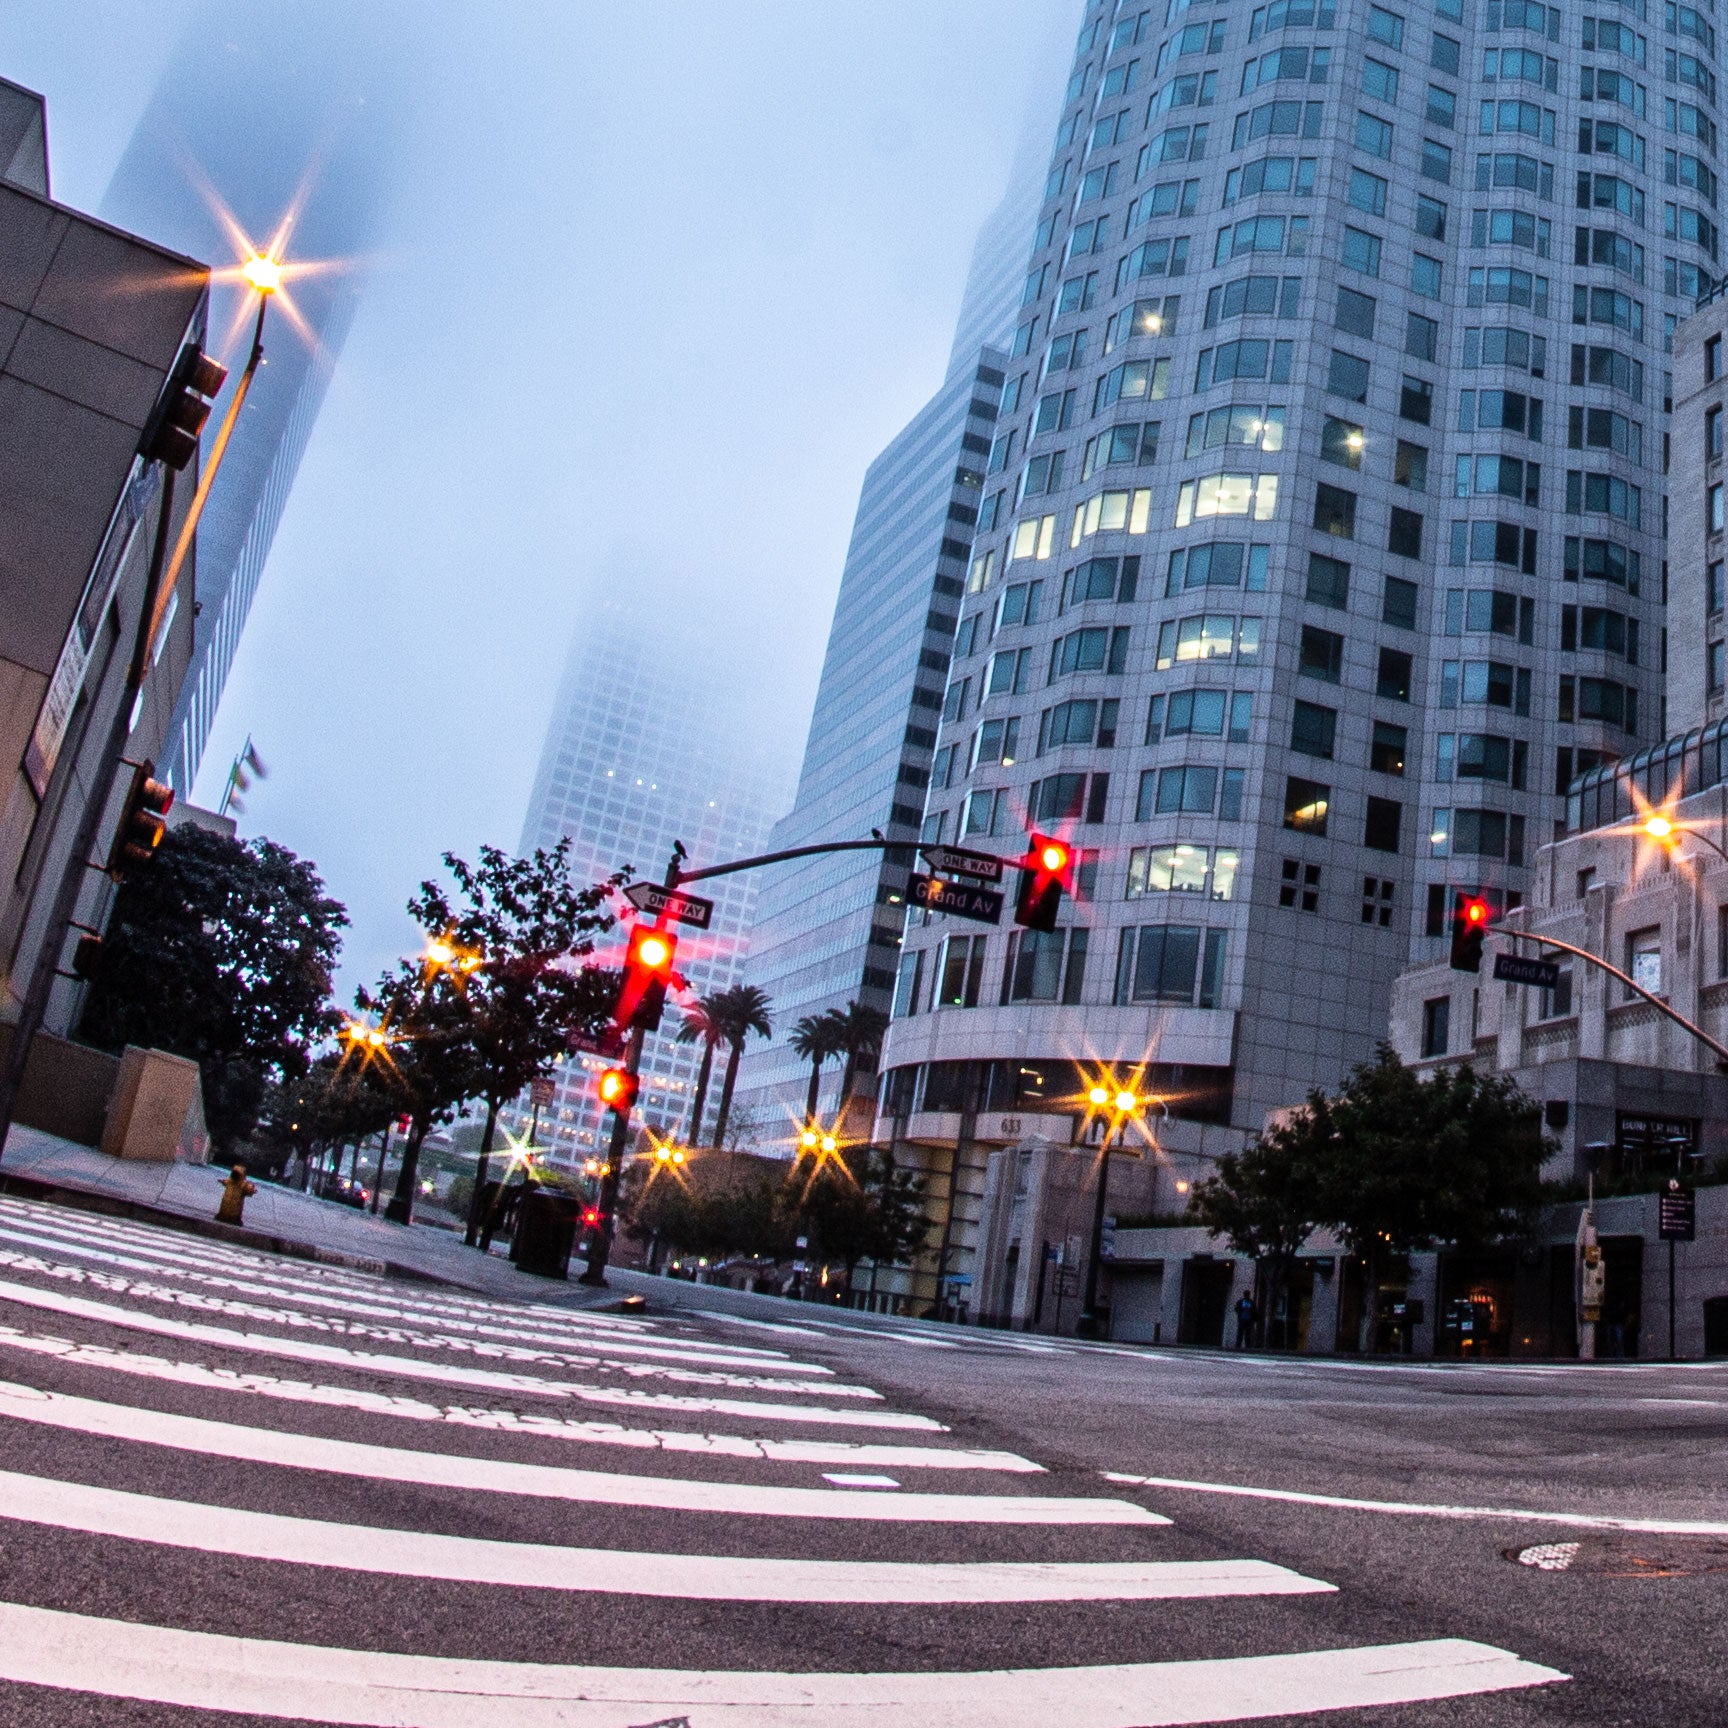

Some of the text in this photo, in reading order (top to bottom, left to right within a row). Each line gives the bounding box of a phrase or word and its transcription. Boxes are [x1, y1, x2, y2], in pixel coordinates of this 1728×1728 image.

[943, 854, 994, 873] ONE WAY
[649, 893, 703, 917] ONE WAY
[915, 881, 994, 913] Grand Av
[1500, 959, 1537, 979] Grand
